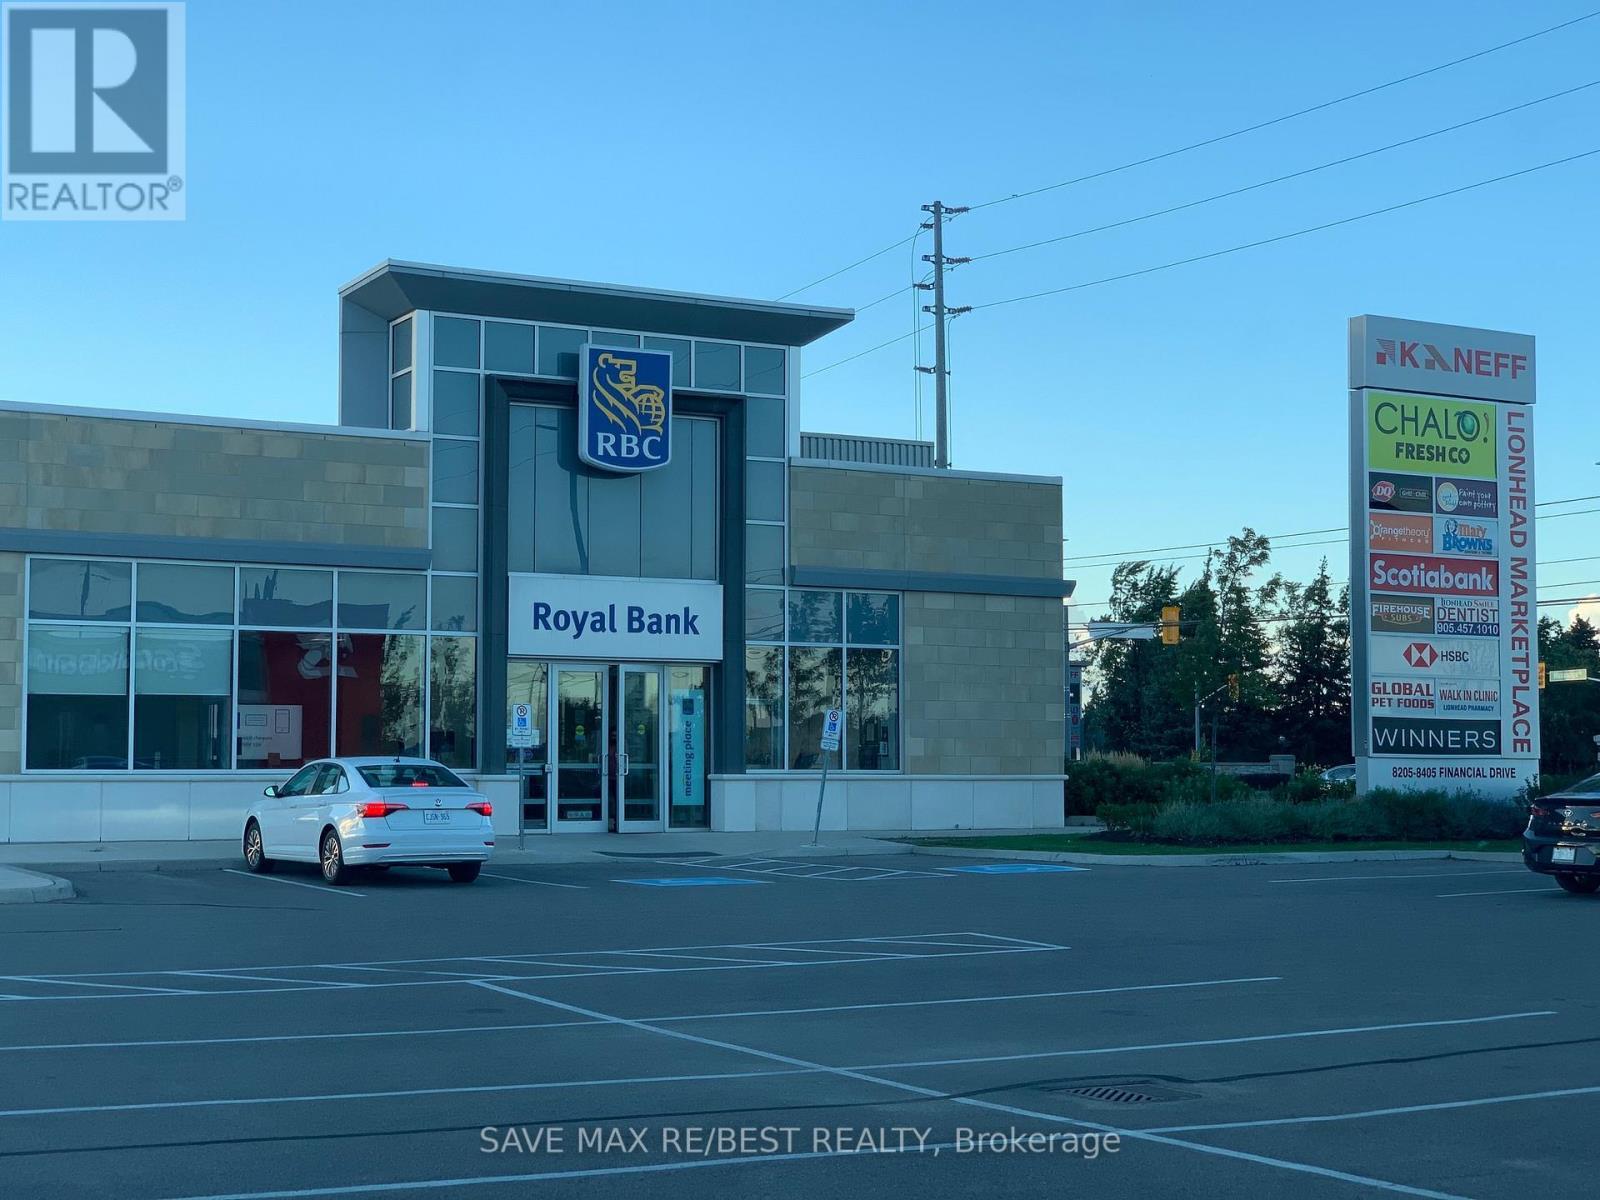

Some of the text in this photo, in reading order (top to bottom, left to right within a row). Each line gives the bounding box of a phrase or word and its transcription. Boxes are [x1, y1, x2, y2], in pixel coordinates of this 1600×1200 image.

[596, 431, 661, 460] RBC
[1376, 485, 1391, 497] DQ
[1373, 560, 1494, 590] Scotiabank
[1507, 411, 1531, 753] LIONHEAD MARKETPLACE
[1372, 604, 1431, 619] FIREHOUSE
[1390, 613, 1412, 621] SUBS
[1437, 607, 1498, 622] DENTIST
[533, 602, 700, 640] Royal Bank
[1437, 623, 1499, 634] 905.457.1010
[1441, 651, 1469, 662] HSBC
[1371, 682, 1434, 696] GLOBAL
[1440, 689, 1498, 702] WALK IN CLINIC
[1371, 697, 1435, 709] PET FOODS
[1374, 728, 1496, 748] WINNERS
[683, 720, 695, 797] meeting place
[1392, 767, 1516, 778] 8205-8405 FINANCIAL DRIVE
